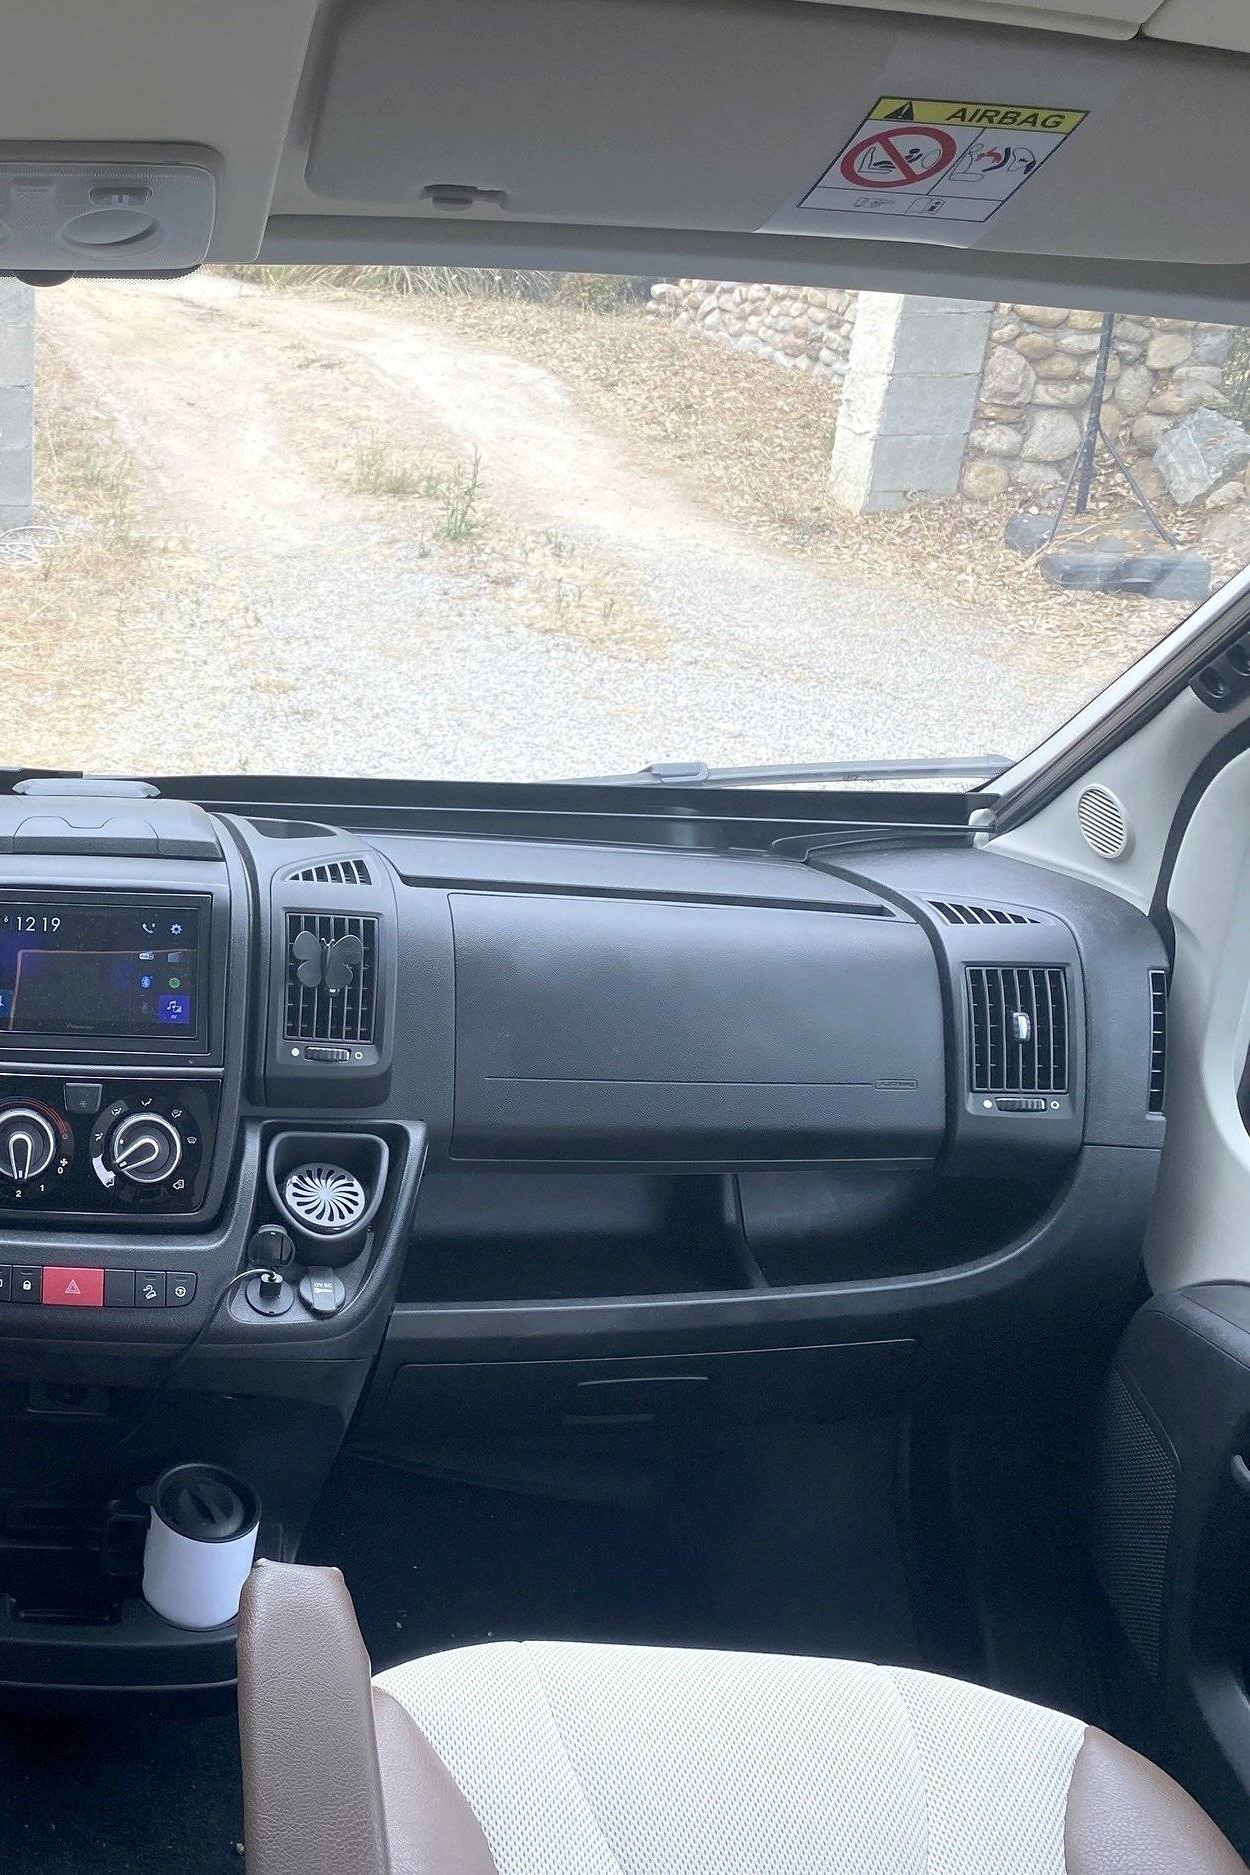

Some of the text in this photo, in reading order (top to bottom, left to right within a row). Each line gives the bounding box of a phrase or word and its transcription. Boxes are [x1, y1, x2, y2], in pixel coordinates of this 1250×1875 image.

[945, 107, 1066, 128] AIRBAG
[40, 1184, 45, 1192] 1
[15, 1190, 22, 1198] 2
